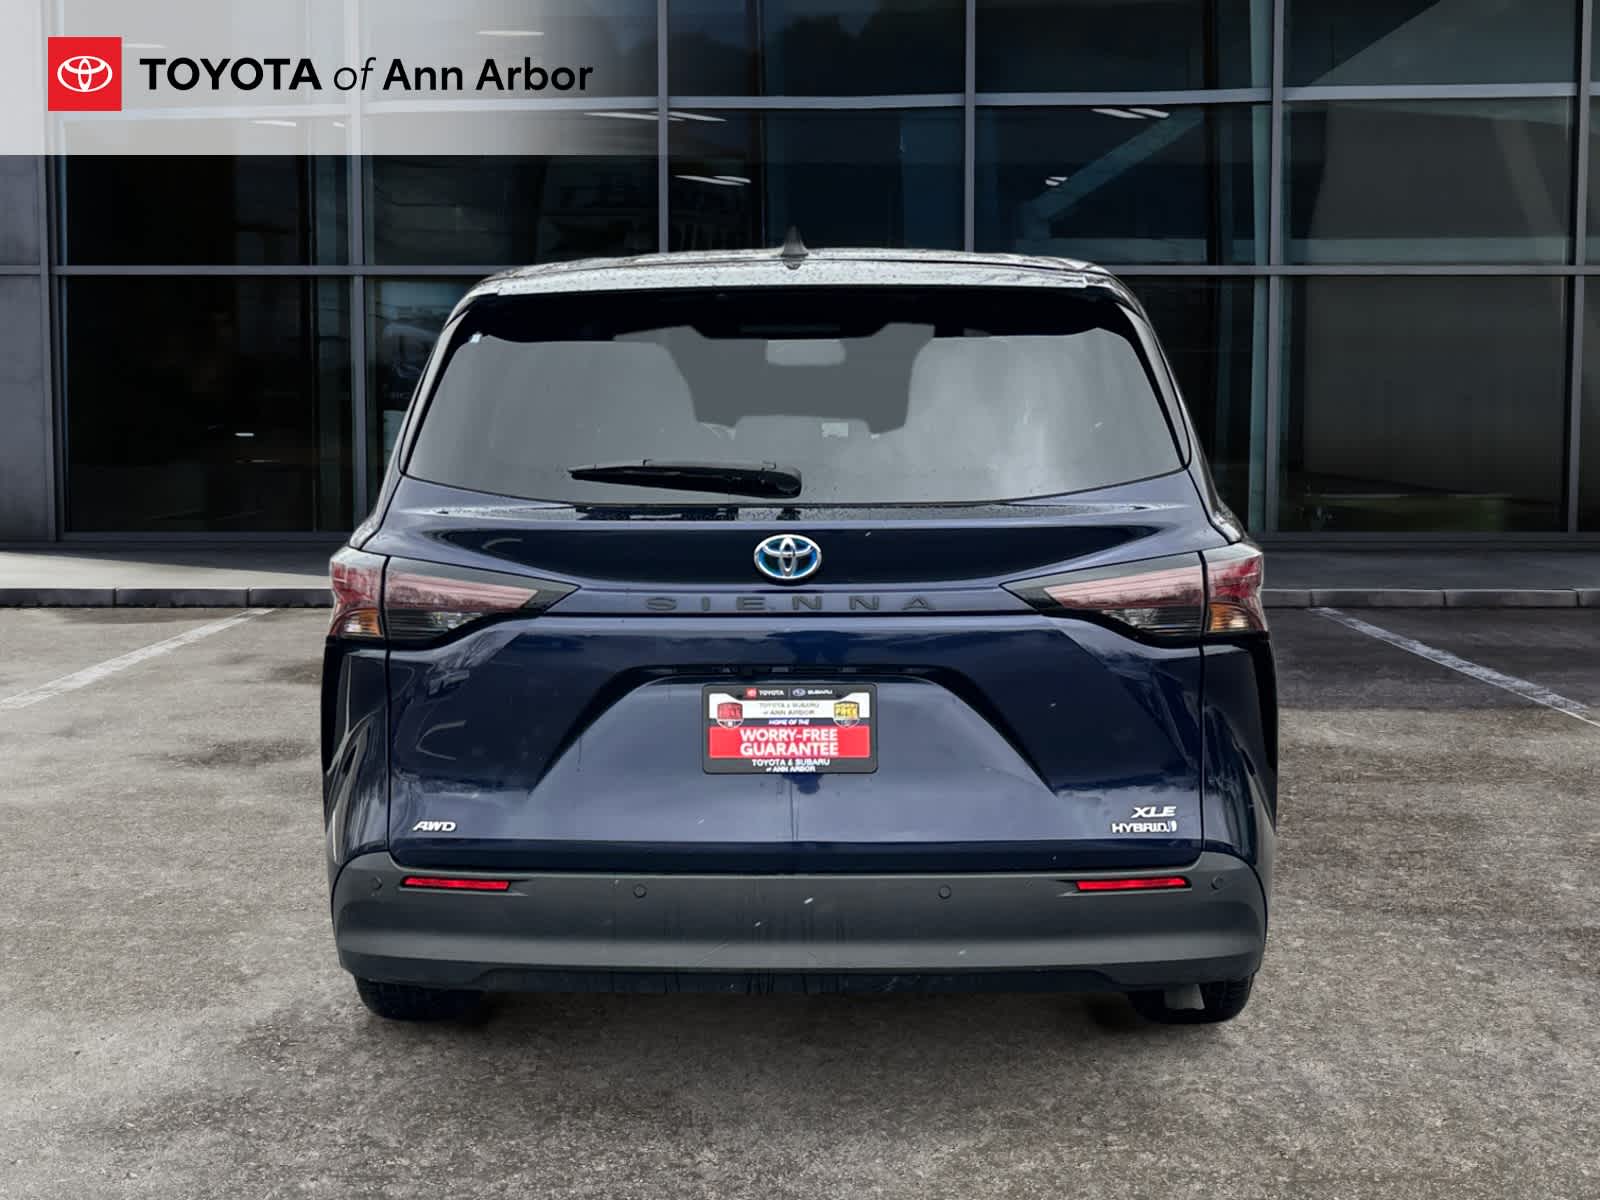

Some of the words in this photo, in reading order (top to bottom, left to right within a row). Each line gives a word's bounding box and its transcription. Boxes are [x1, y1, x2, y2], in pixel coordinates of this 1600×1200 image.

[645, 596, 936, 611] SIENNA
[759, 689, 785, 697] TOYOTA
[740, 728, 838, 742] WORRY-FREE
[740, 742, 839, 756] GUARANTEE
[751, 758, 786, 767] TOYOTA
[787, 758, 793, 766] &
[795, 758, 830, 766] SUBARU
[1131, 806, 1177, 819] XLE
[412, 821, 457, 832] AWD
[1111, 822, 1168, 833] HYBRID
